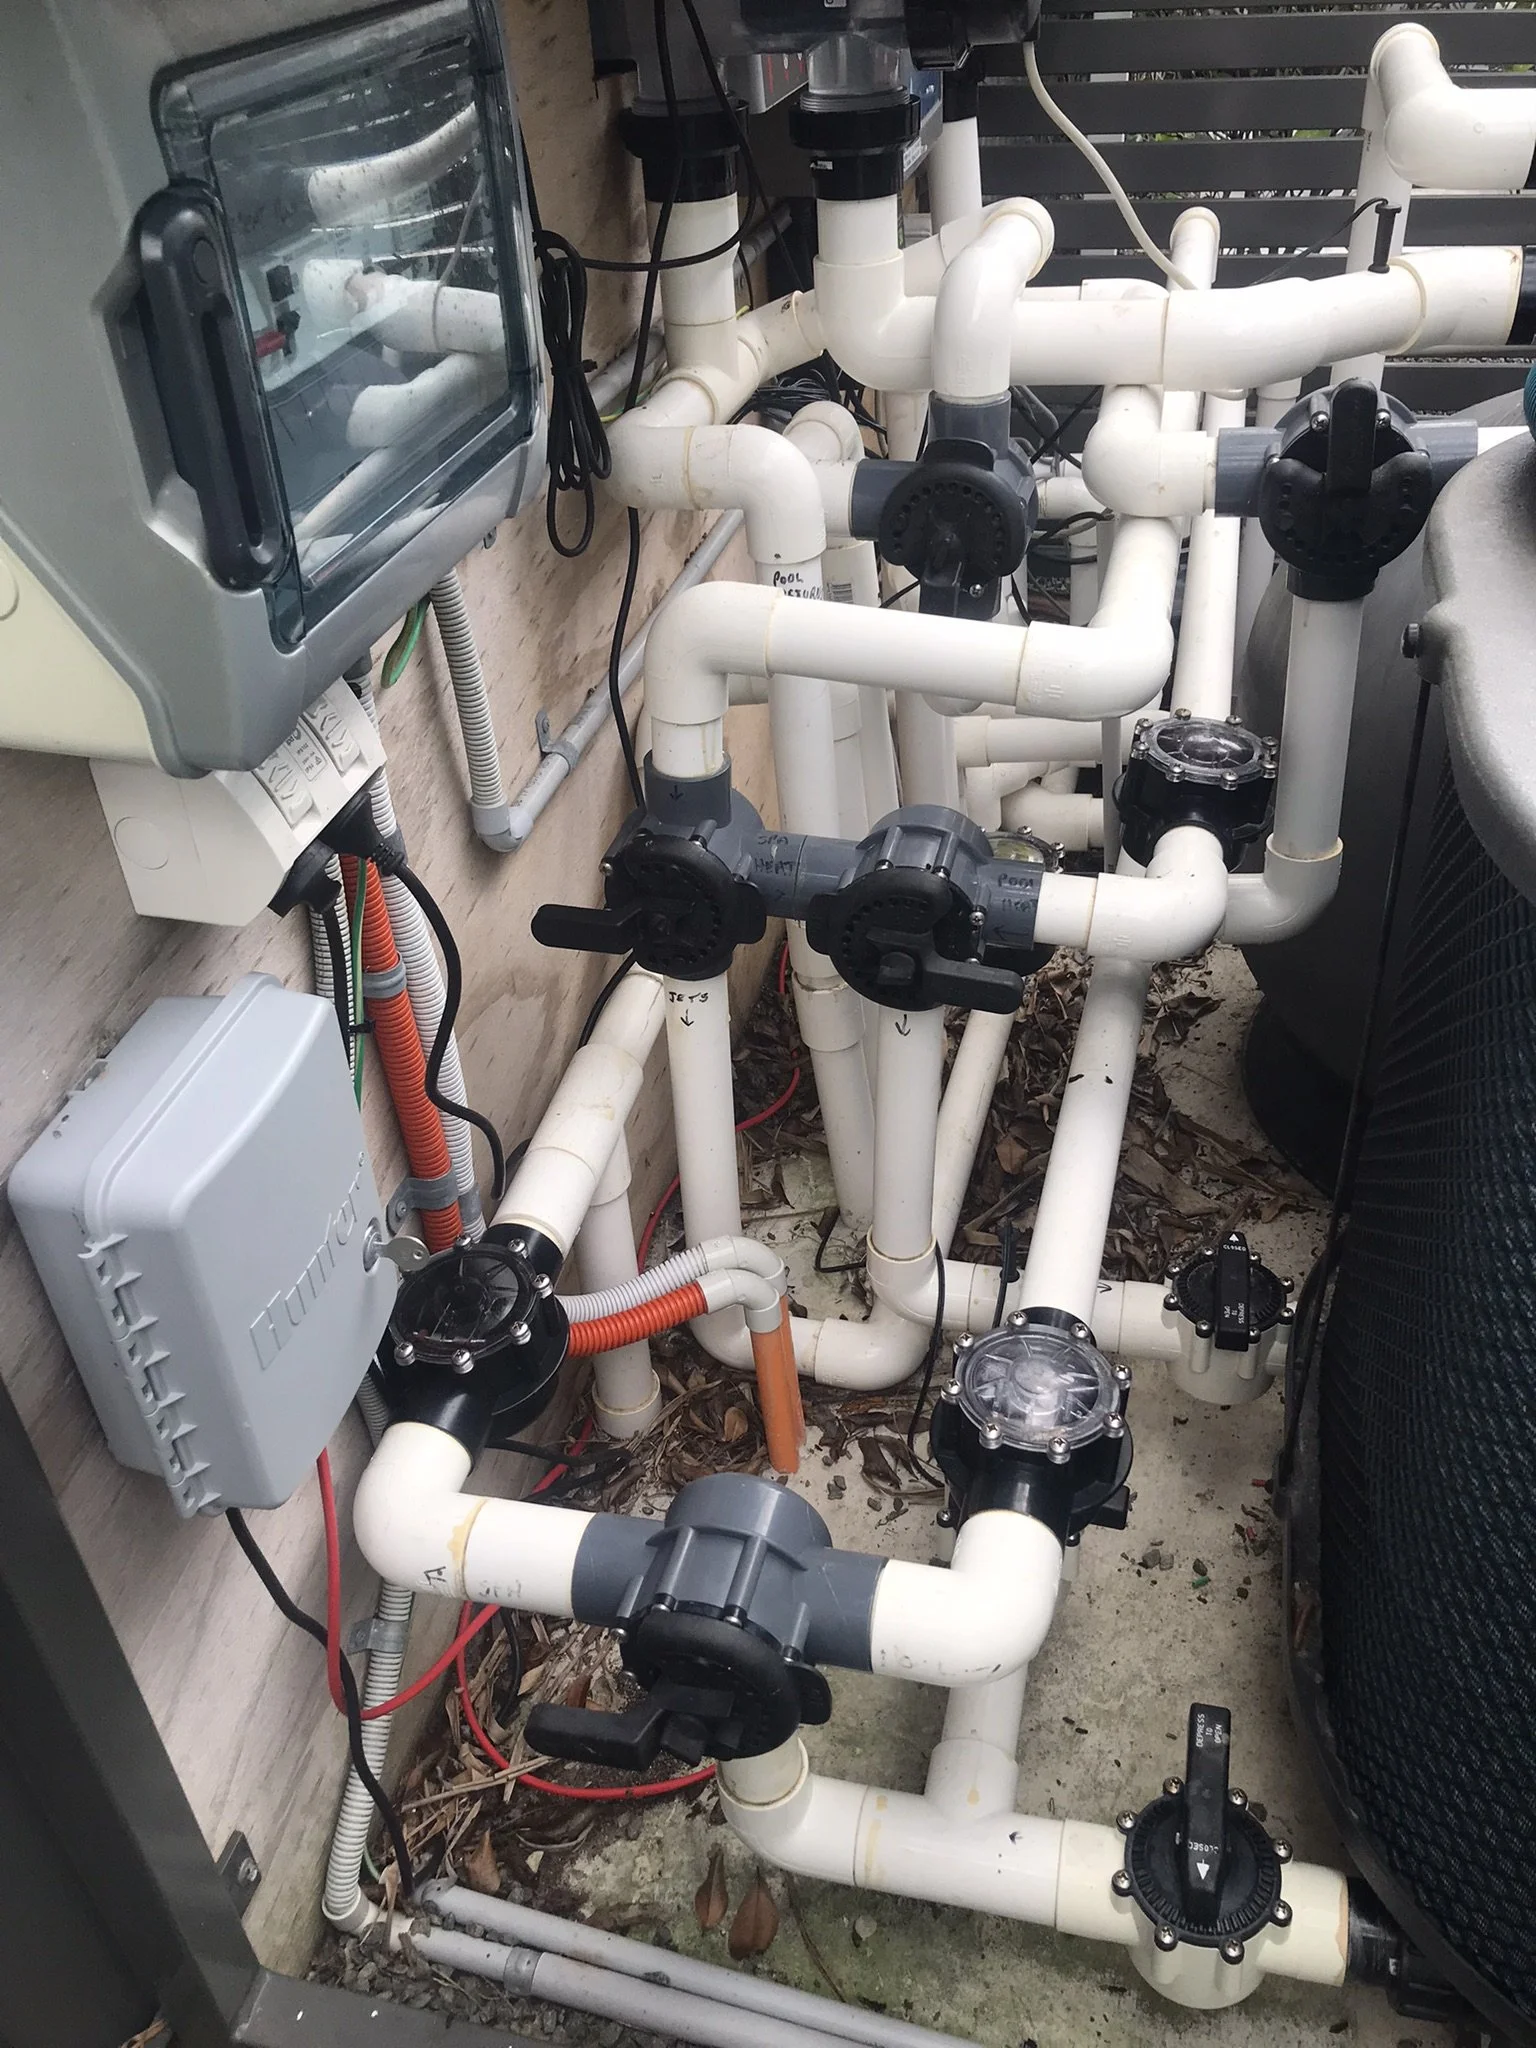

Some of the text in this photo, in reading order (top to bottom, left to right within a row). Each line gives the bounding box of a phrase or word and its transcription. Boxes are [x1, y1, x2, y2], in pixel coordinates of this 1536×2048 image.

[668, 991, 709, 1003] JETS
[1222, 1243, 1247, 1252] CLOSED
[1223, 1305, 1231, 1318] OPEN
[1237, 1302, 1245, 1324] DEPRESS
[1195, 1713, 1206, 1748] DEPRESS
[1205, 1727, 1213, 1737] TO
[1213, 1723, 1223, 1744] OPEN
